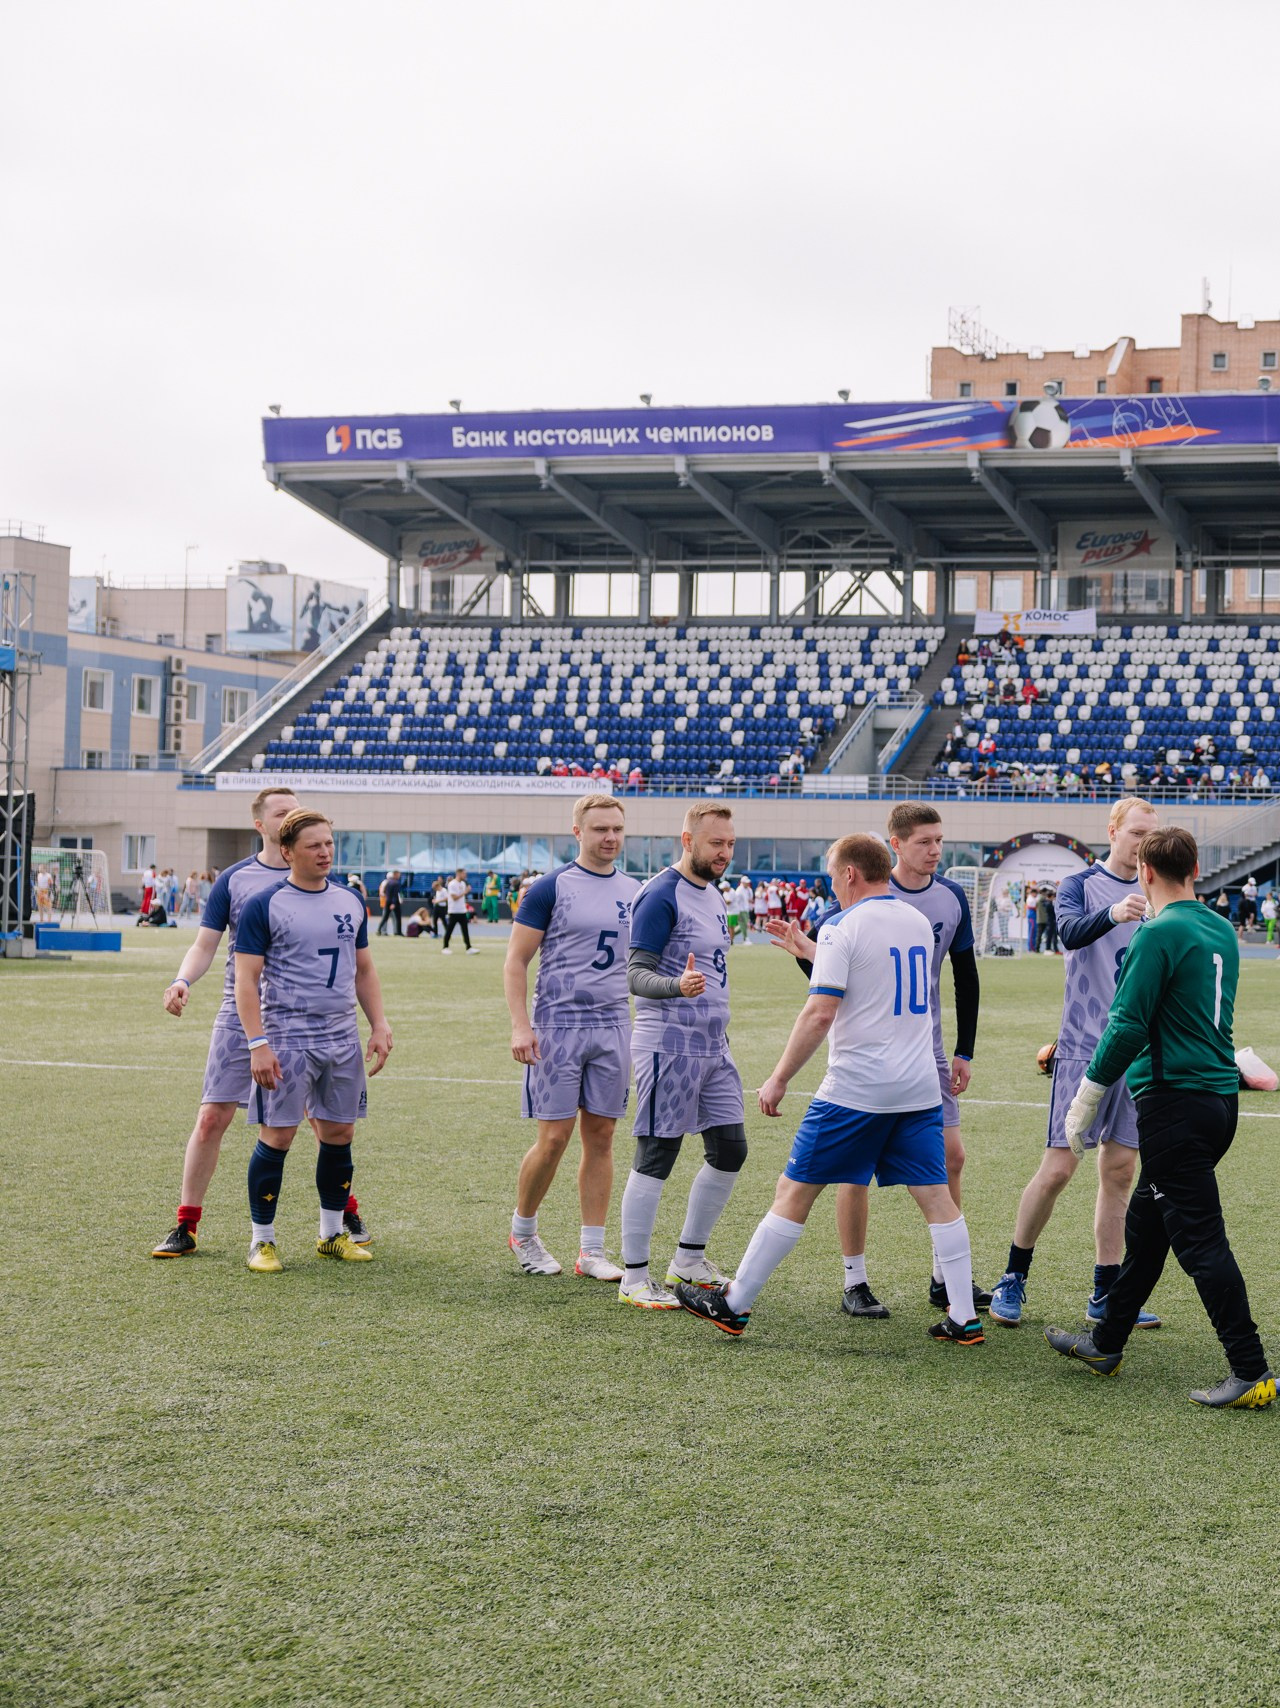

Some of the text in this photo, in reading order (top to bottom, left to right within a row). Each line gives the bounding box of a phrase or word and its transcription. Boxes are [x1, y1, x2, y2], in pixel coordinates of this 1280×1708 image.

[355, 428, 403, 450] ПСБ
[451, 424, 775, 448] Банк настоящих чемпионов
[1025, 611, 1070, 621] КОМОС
[232, 777, 301, 785] ПРИВЕТСТВУЕМ
[307, 778, 367, 786] УЧАСТНИКОВ
[372, 779, 442, 789] СПАРТАКИАДЫ
[447, 779, 521, 789] АГРОХОЛДИНГА
[591, 930, 619, 971] 5
[318, 947, 339, 988] 7
[889, 945, 928, 1016] 10
[1212, 952, 1223, 1030] 1
